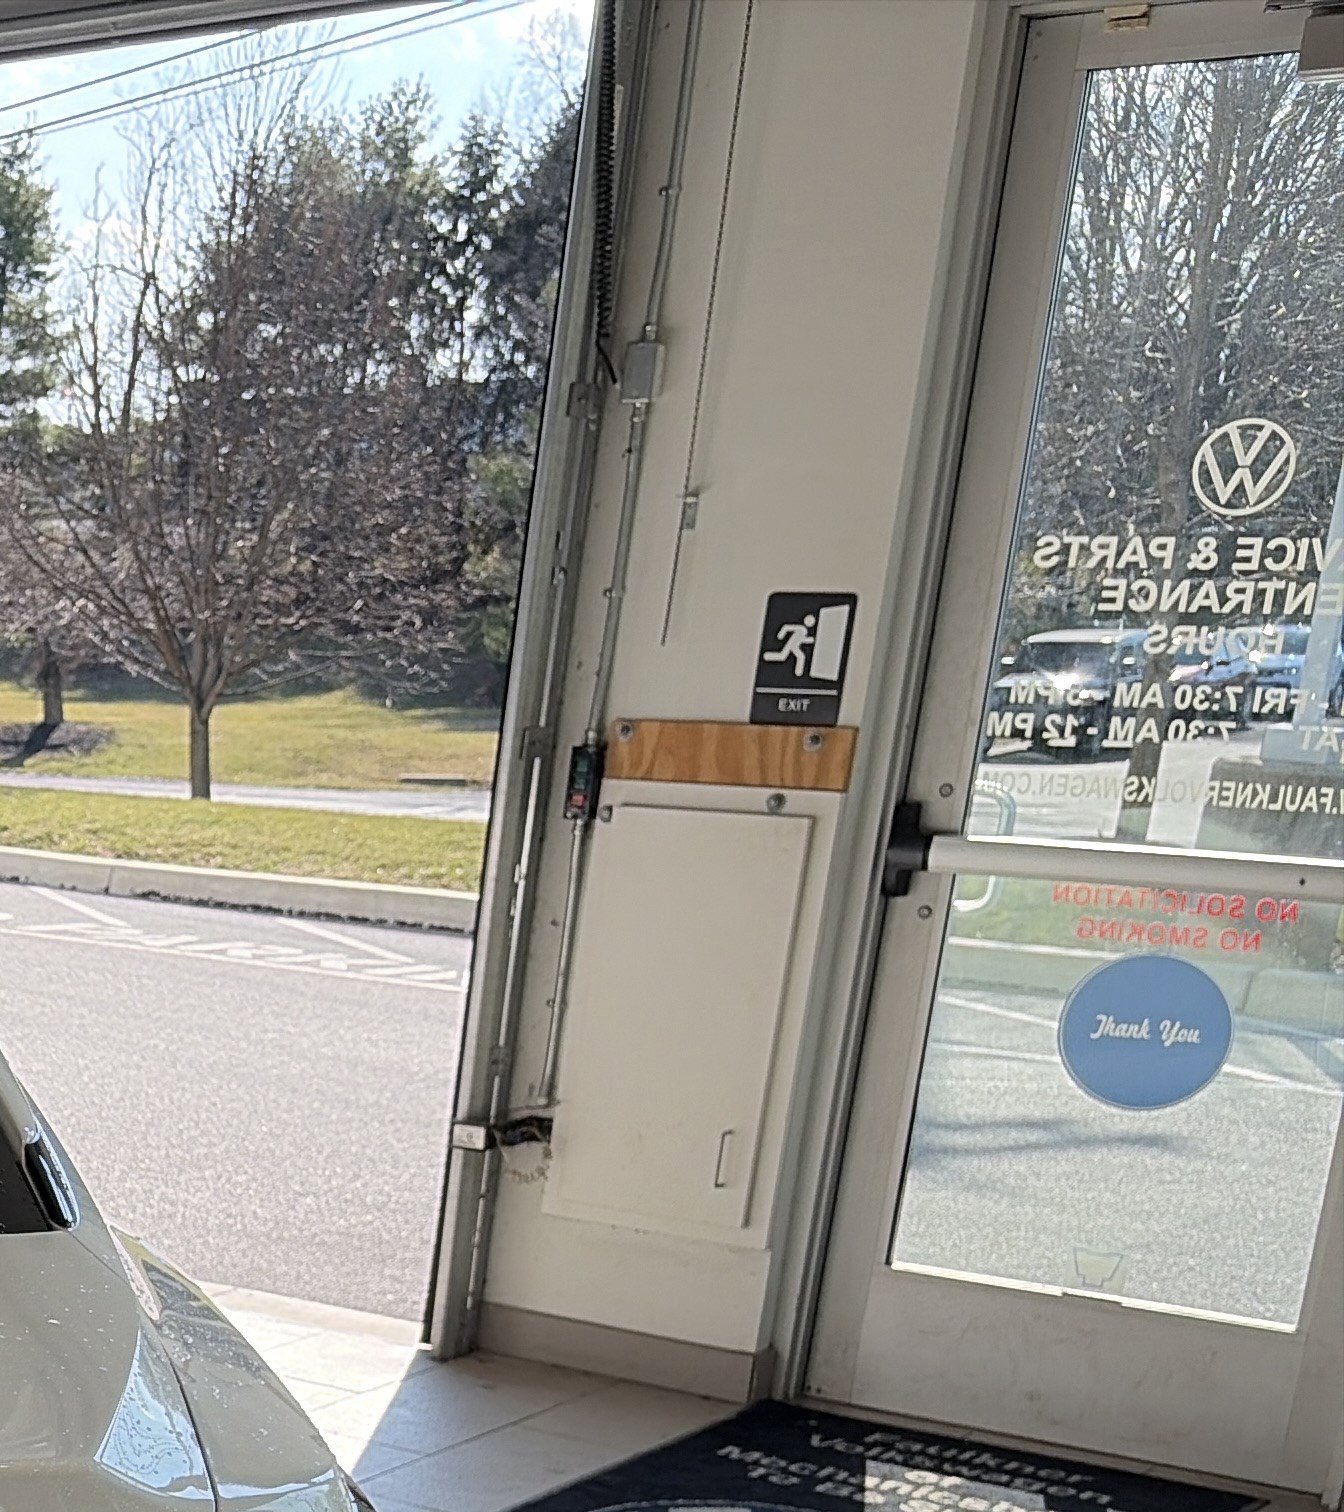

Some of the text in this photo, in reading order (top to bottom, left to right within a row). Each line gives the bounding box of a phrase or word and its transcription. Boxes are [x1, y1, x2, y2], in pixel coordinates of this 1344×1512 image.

[777, 698, 811, 713] EXIT
[1090, 1014, 1202, 1047] Thank You
